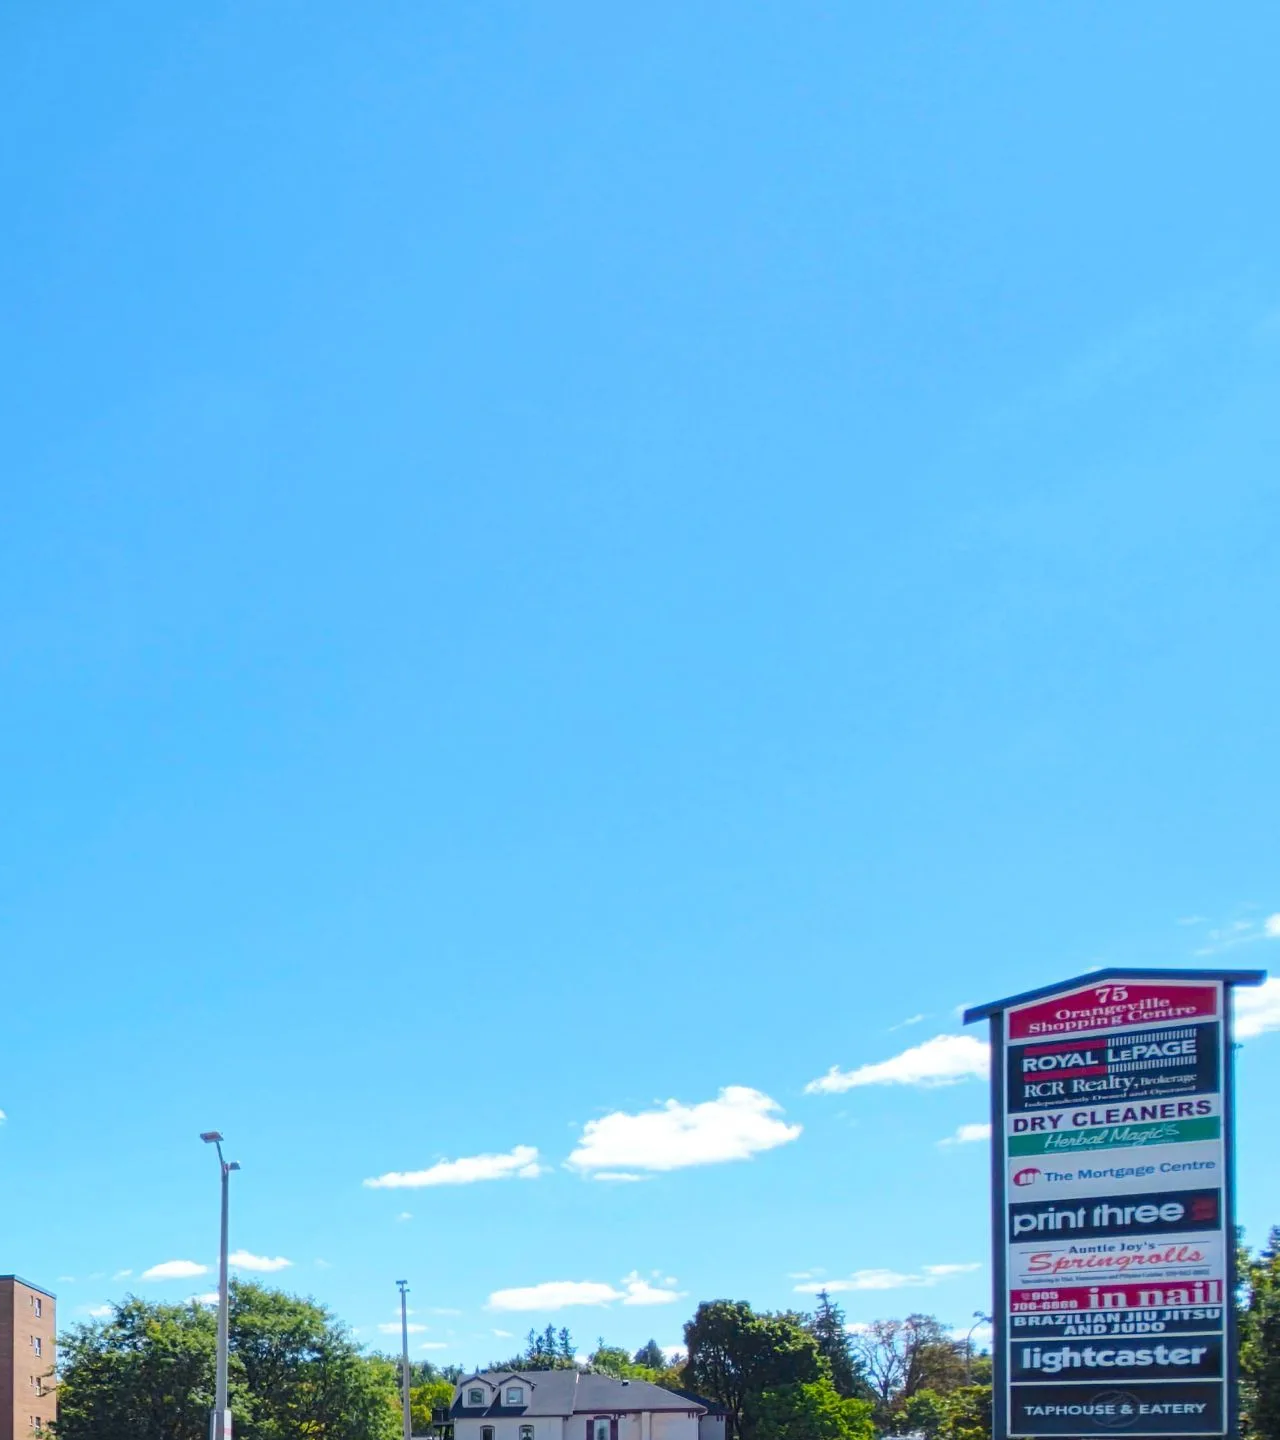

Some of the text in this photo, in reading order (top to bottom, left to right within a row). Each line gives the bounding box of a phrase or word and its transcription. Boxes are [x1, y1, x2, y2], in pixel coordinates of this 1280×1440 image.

[1095, 985, 1128, 1004] 75
[1028, 1005, 1197, 1033] Shopping Centre
[1055, 997, 1170, 1020] Orangeville
[1022, 1051, 1099, 1073] ROYAL
[1023, 1073, 1197, 1098] RCR Realty, Brokerage
[1013, 1100, 1212, 1133] DRY CLEANERS
[1044, 1130, 1108, 1148] Herbal
[1043, 1158, 1216, 1182] The Mortgage Centre
[1013, 1201, 1185, 1236] print three
[1068, 1241, 1157, 1255] Auntie Joy's
[1027, 1245, 1206, 1275] Springrolls
[1088, 1281, 1222, 1309] in nail
[1013, 1308, 1221, 1327] BRAZILIAN JIU JITSU
[1063, 1321, 1166, 1336] AND JUDO
[1021, 1344, 1208, 1373] lightcaster
[1023, 1402, 1207, 1416] TAPHOUSE & EATERY
